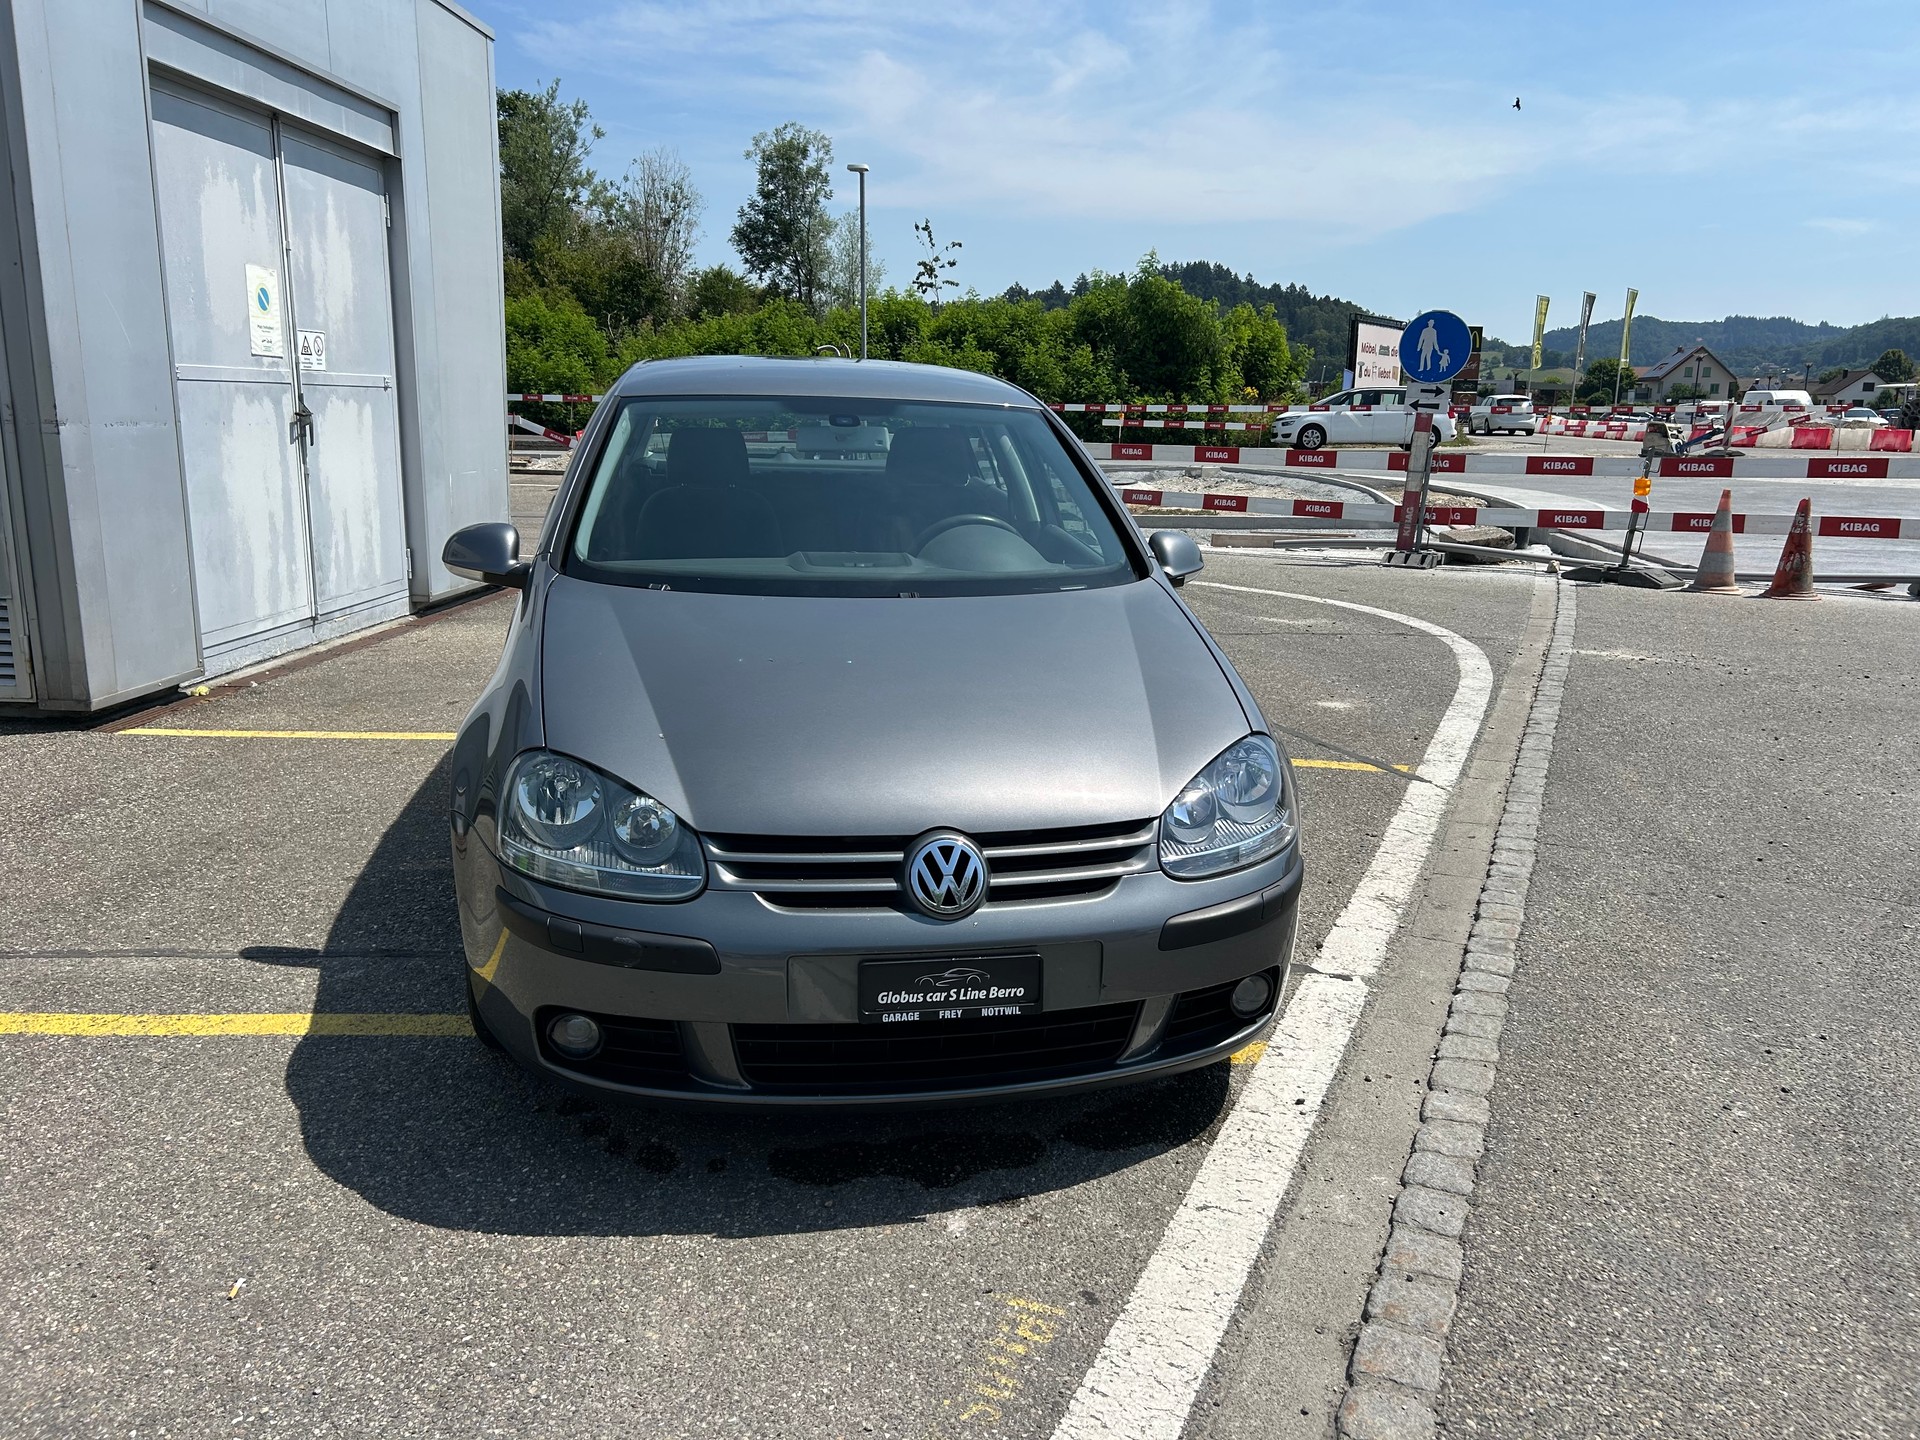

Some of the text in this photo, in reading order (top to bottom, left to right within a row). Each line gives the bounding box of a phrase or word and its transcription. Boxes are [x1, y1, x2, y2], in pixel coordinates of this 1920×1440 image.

[1361, 342, 1377, 356] Möbel,
[1364, 366, 1391, 379] du liebst
[1206, 451, 1228, 459] KIBAG
[1299, 454, 1324, 463] KIBAG
[1543, 462, 1576, 470] KIBAG
[1678, 463, 1714, 472] KIBAG
[1828, 464, 1868, 473] KIBAG
[1132, 493, 1152, 501] KIBAG
[1214, 499, 1237, 507] KIBAG
[1305, 504, 1331, 513] KIBAG
[1403, 506, 1415, 537] KIBAG
[1554, 515, 1587, 524] KIBAG
[1840, 522, 1880, 532] KIBAG
[877, 986, 1025, 1004] Globus car S Line Berro
[882, 1006, 1021, 1023] GARAGE FREY NOTTWIL
